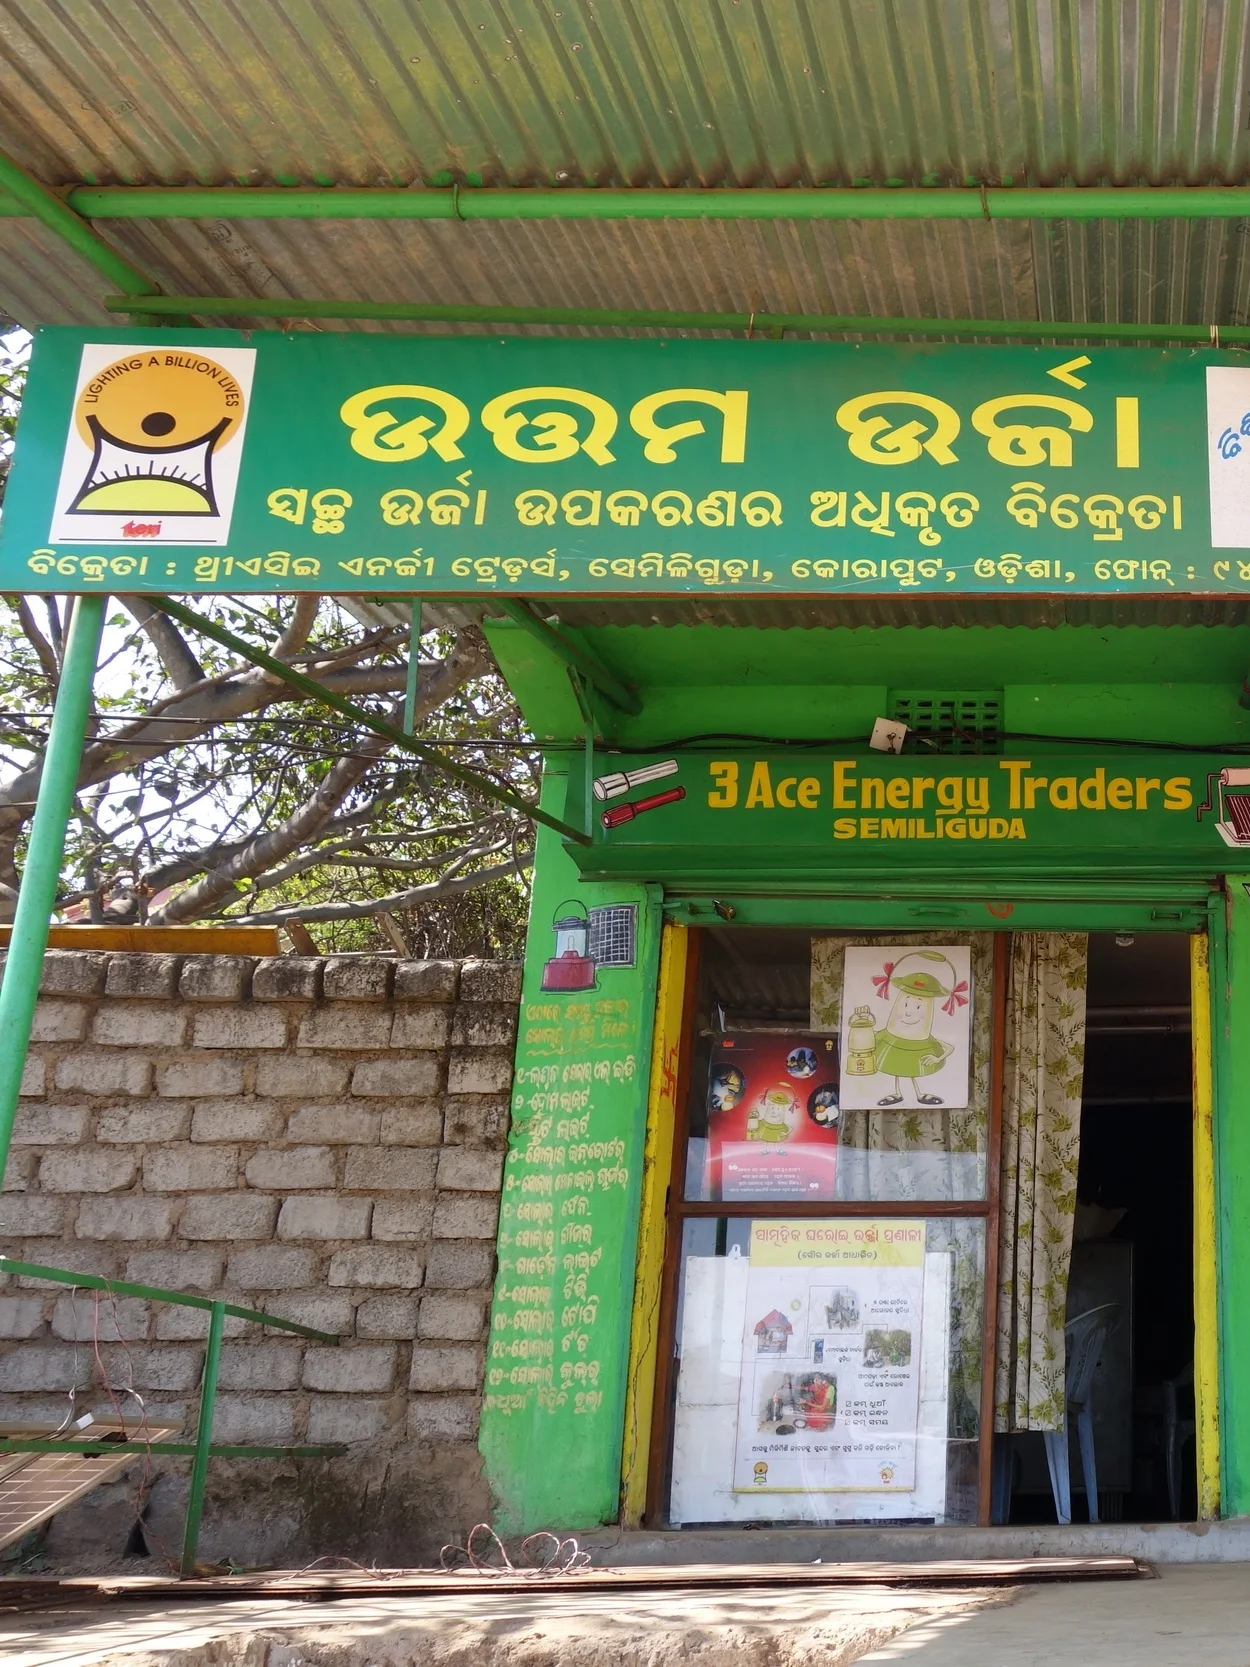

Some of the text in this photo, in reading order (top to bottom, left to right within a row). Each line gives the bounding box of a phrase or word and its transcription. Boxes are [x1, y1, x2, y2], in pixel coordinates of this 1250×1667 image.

[85, 356, 239, 407] LIGHTING A BILLION LIVES
[120, 520, 162, 538] teri
[707, 760, 1194, 815] 3 Ace Energy Traders
[833, 817, 1027, 840] SEMILIGUDA
